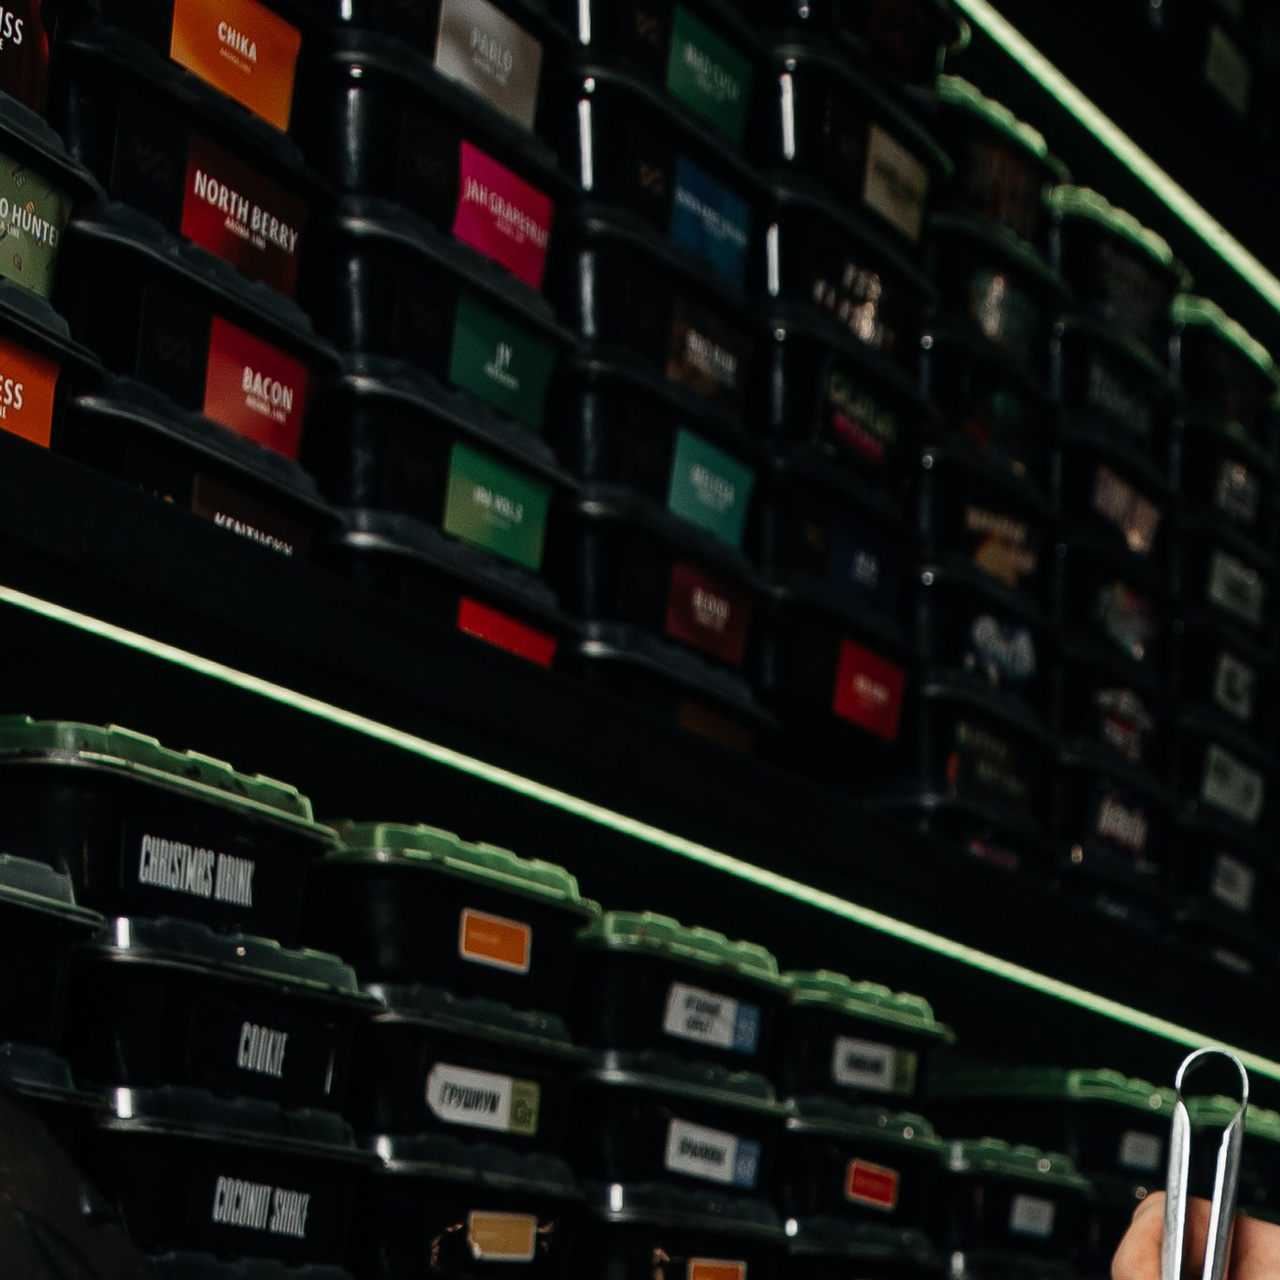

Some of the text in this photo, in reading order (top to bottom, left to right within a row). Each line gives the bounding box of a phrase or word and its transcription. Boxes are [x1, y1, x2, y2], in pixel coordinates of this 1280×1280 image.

[217, 20, 258, 64] CHIKA
[193, 168, 299, 255] NORTH BERRY
[241, 365, 294, 415] BACON
[138, 833, 215, 899] CHRISTMAS
[236, 1020, 289, 1078] COOKIE
